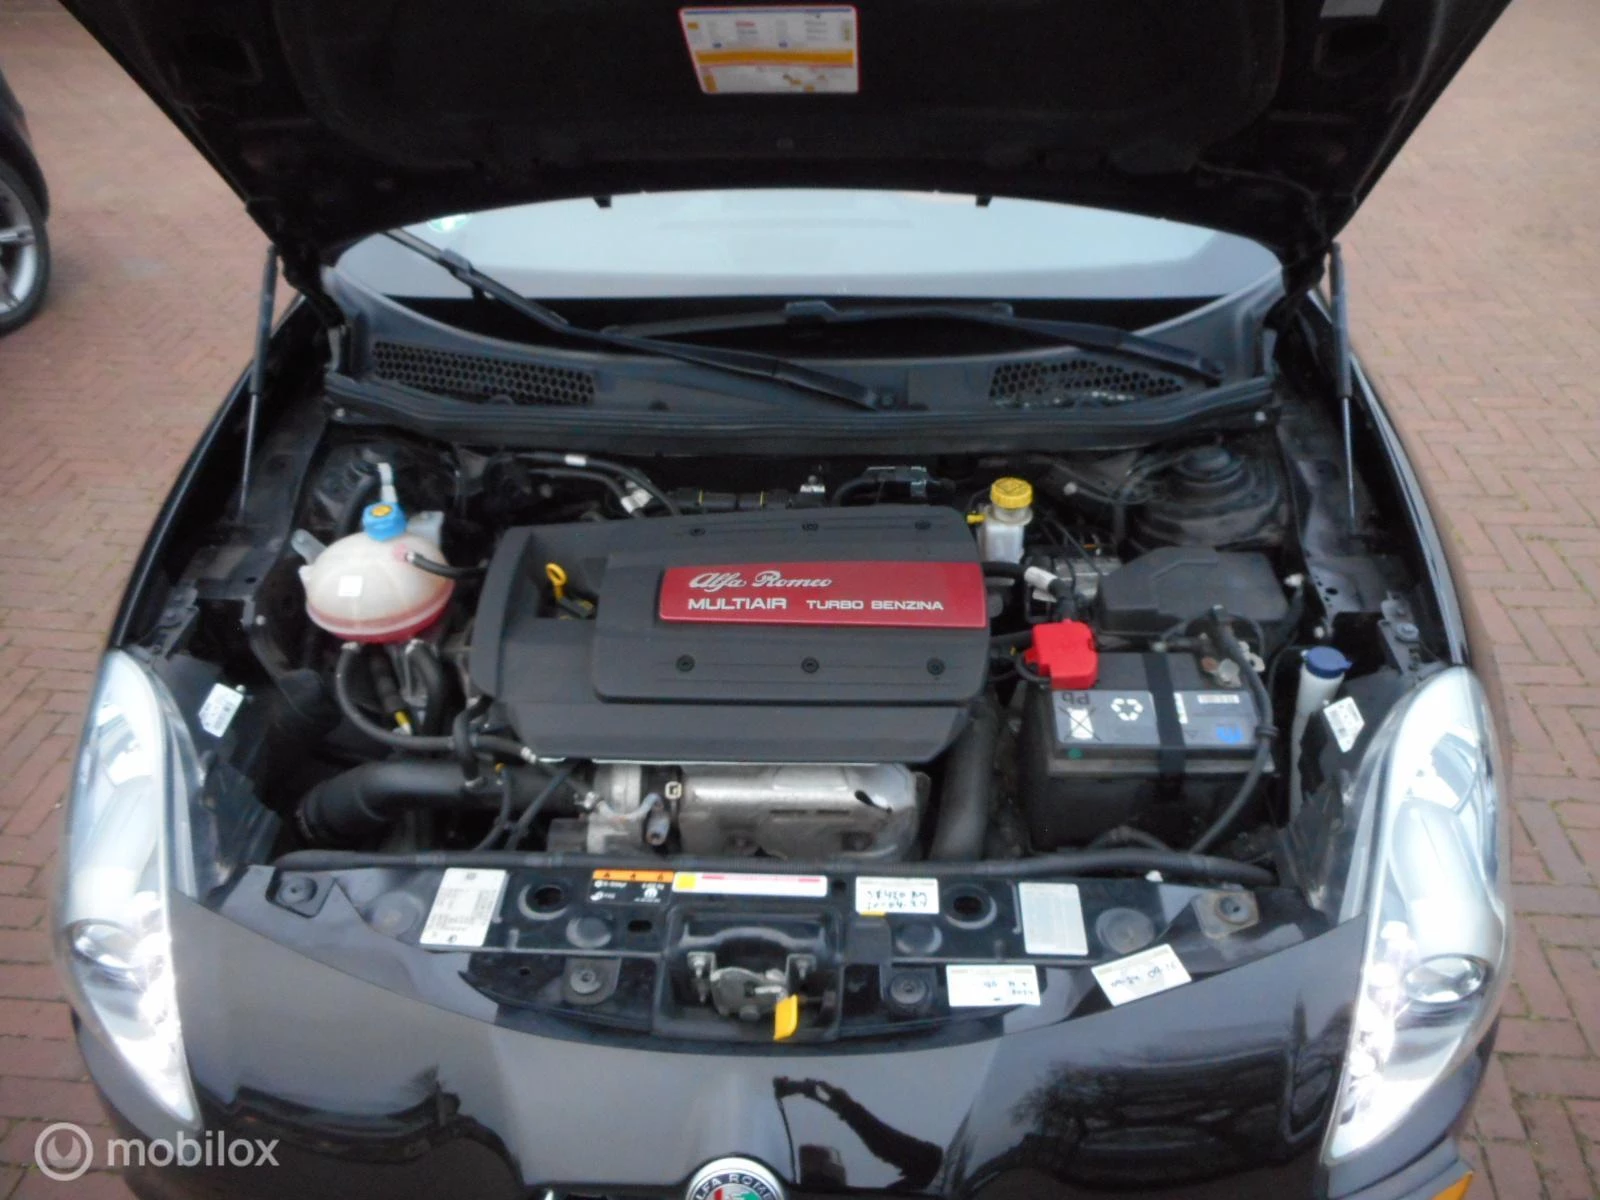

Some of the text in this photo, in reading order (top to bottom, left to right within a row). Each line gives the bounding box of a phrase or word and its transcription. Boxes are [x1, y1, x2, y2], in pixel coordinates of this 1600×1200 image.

[688, 570, 833, 592] Alfa Romeo
[687, 597, 945, 611] MULTIAIR TURBO BENZINA
